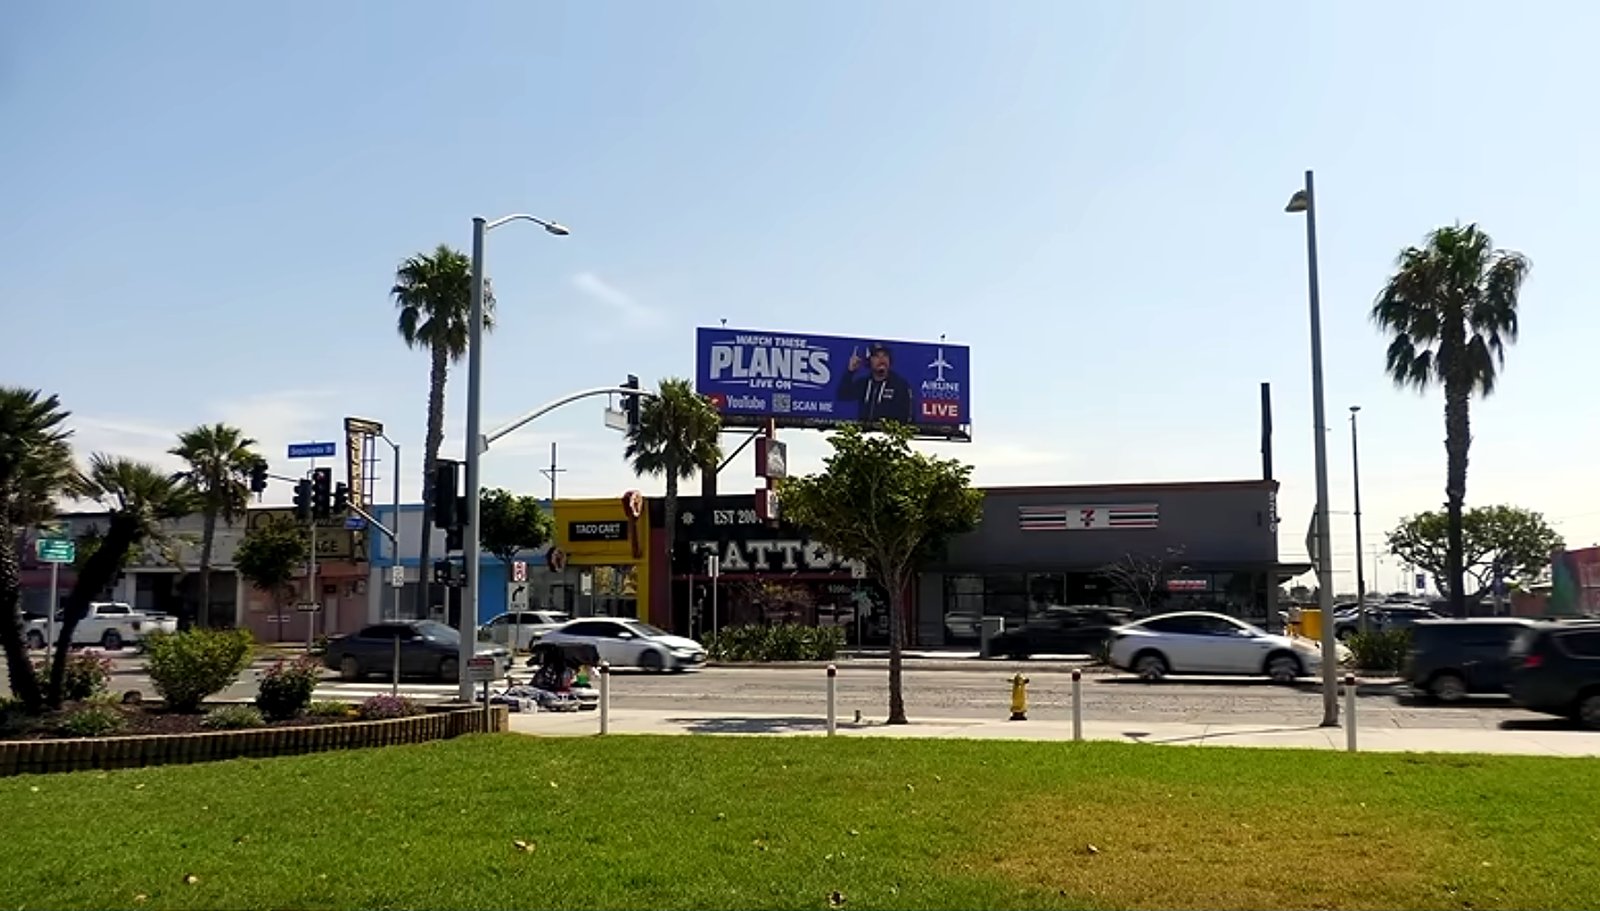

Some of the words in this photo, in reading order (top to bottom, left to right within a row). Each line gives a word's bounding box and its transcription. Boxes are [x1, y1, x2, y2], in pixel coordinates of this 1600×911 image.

[736, 335, 773, 347] WATCH
[775, 337, 808, 349] THESE
[709, 345, 830, 384] PLANES
[749, 378, 774, 389] LIVE
[775, 380, 792, 390] ON
[921, 380, 960, 392] AIRLINE
[725, 394, 767, 411] YouTube
[792, 400, 818, 412] SCAN
[819, 401, 834, 413] ME
[922, 403, 958, 417] LIVE
[713, 510, 735, 524] EST
[737, 510, 763, 524] 200
[575, 524, 598, 534] TACO
[598, 523, 620, 534] CART
